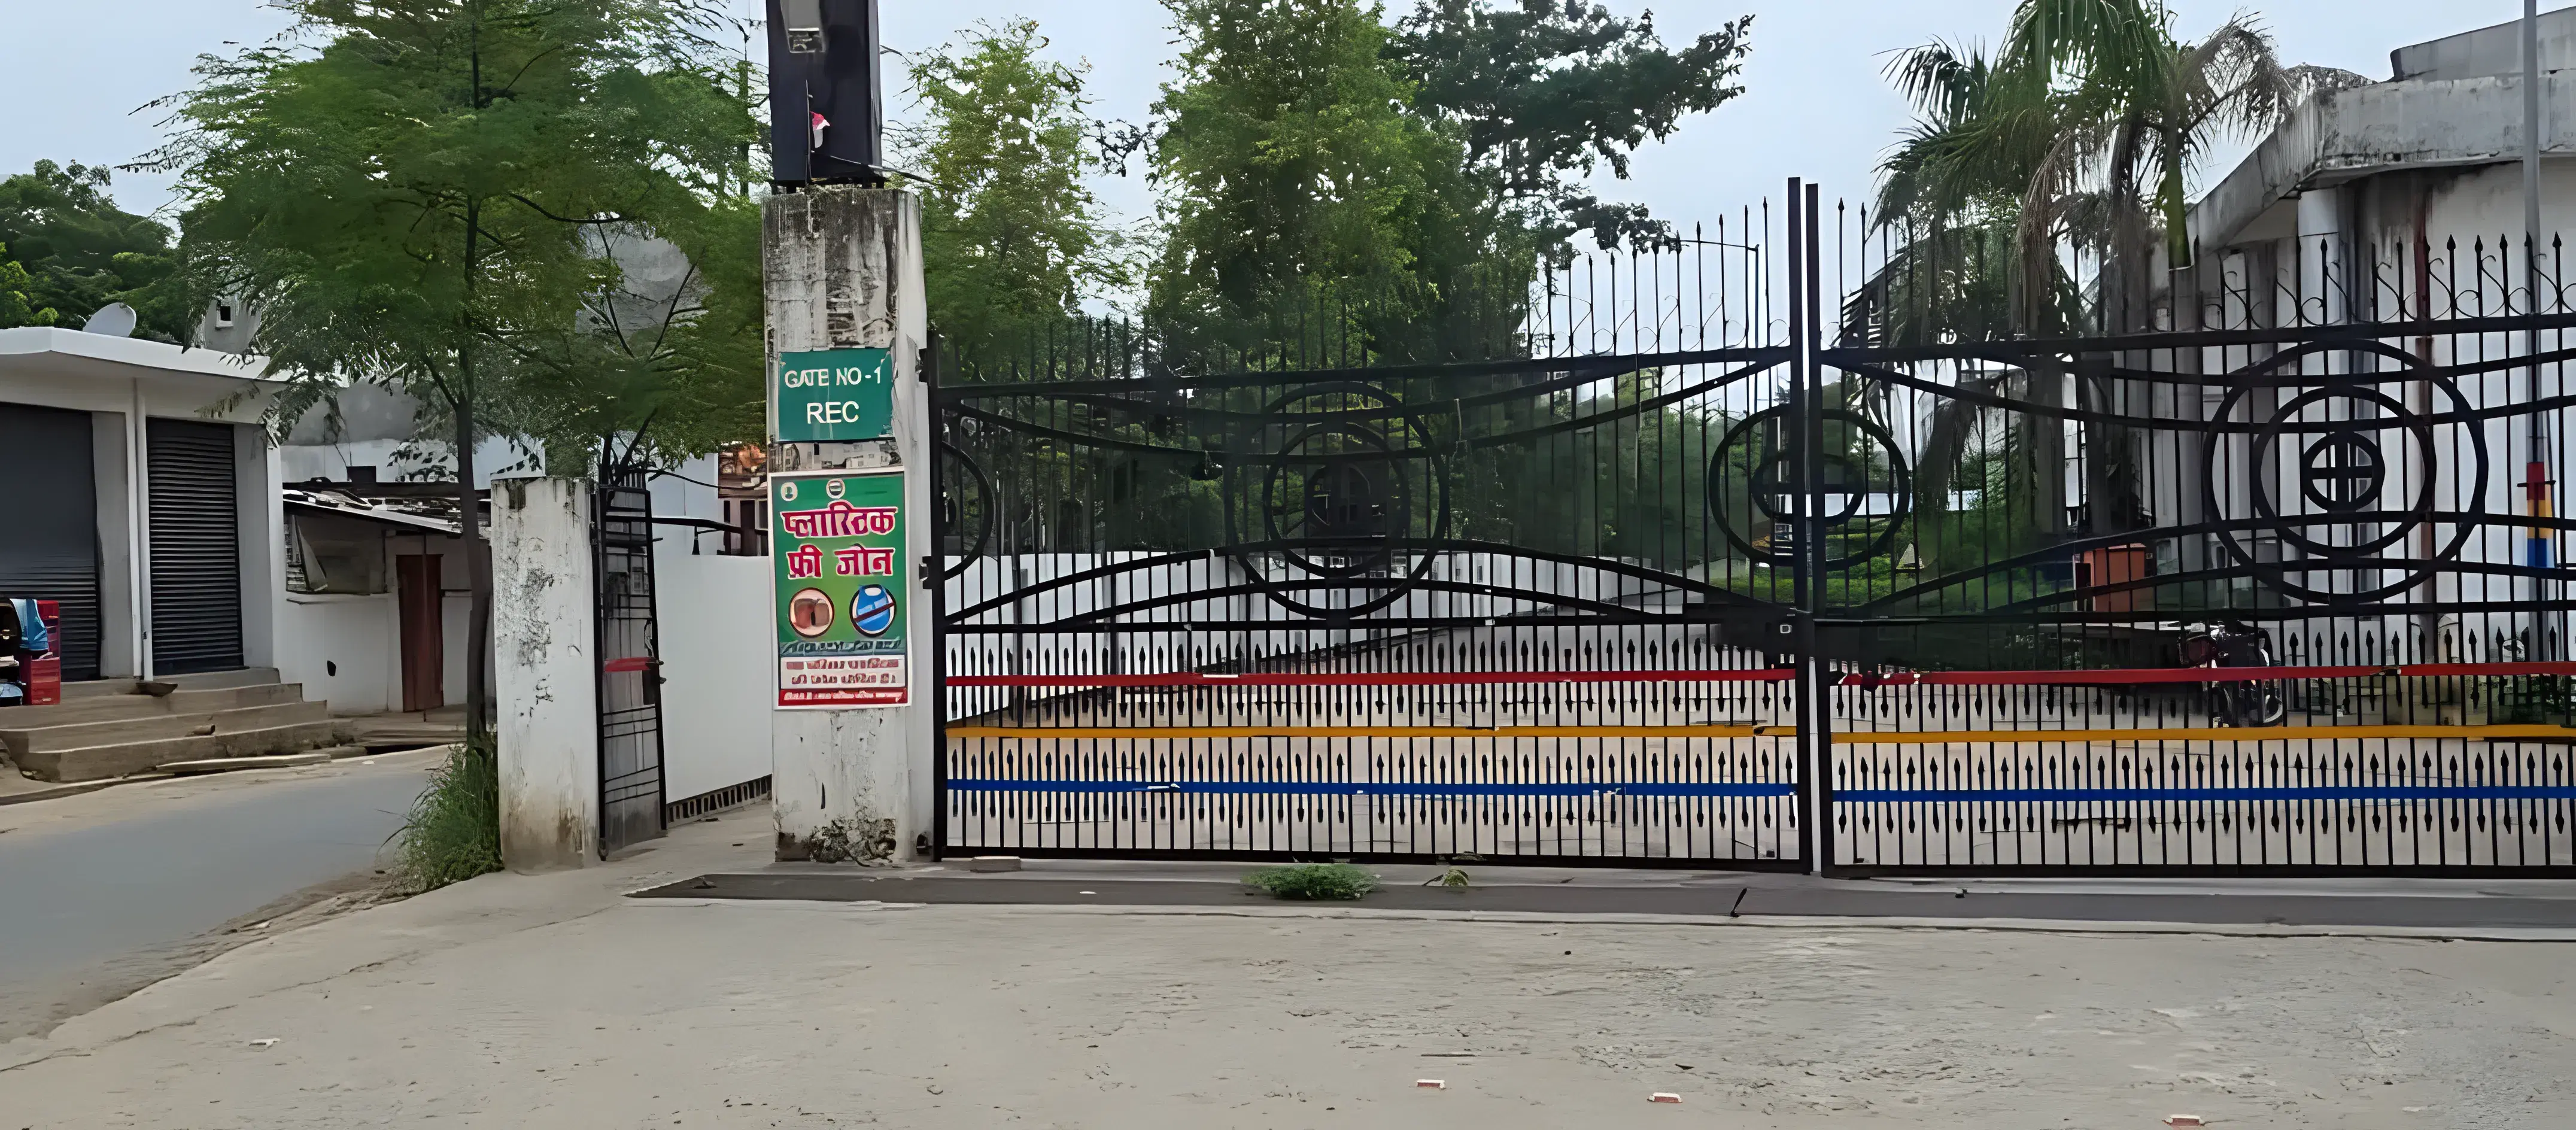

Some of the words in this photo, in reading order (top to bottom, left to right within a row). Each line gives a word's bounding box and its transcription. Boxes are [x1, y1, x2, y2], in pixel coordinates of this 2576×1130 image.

[785, 369, 830, 388] GATE
[807, 400, 859, 424] REC
[834, 543, 895, 576] जोन
